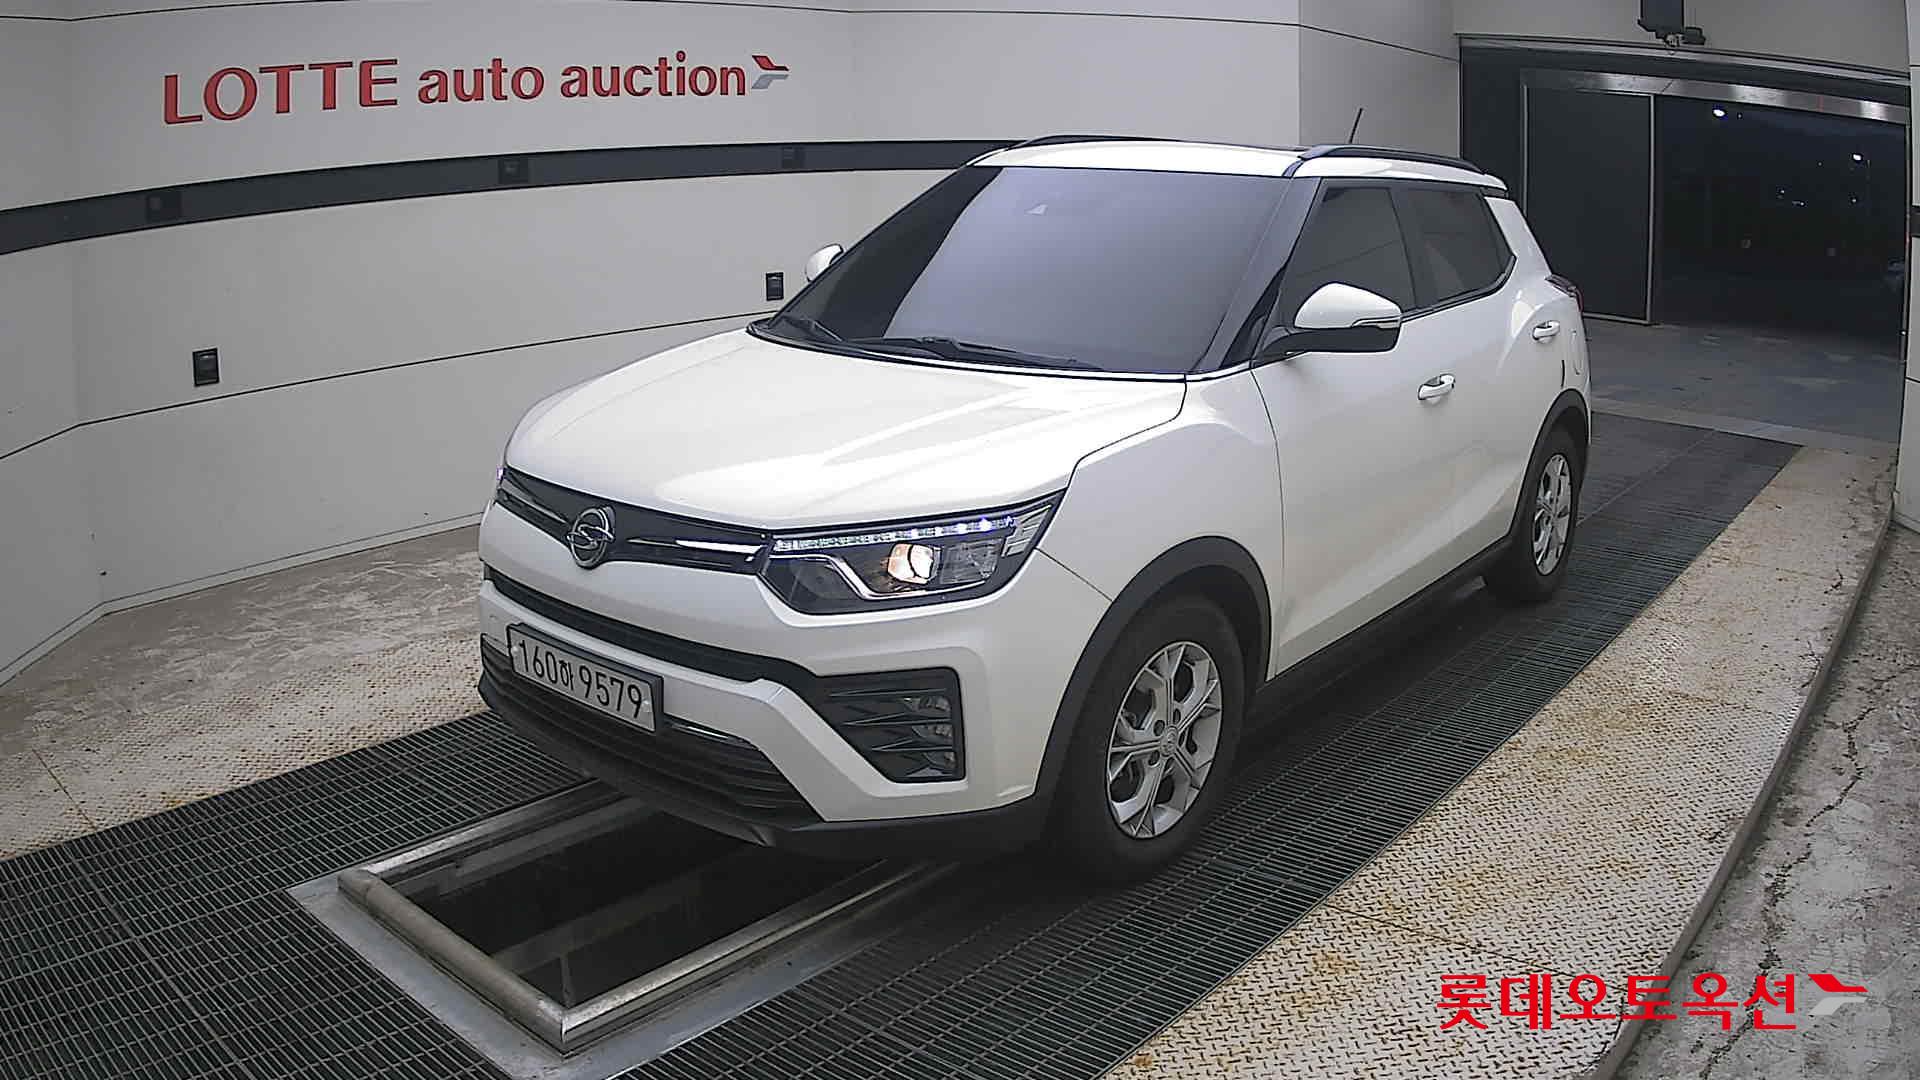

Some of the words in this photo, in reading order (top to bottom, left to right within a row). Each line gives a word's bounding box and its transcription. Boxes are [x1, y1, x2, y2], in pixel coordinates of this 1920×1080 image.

[163, 58, 399, 125] LOTTE
[417, 57, 545, 104] auto
[560, 49, 747, 99] auction
